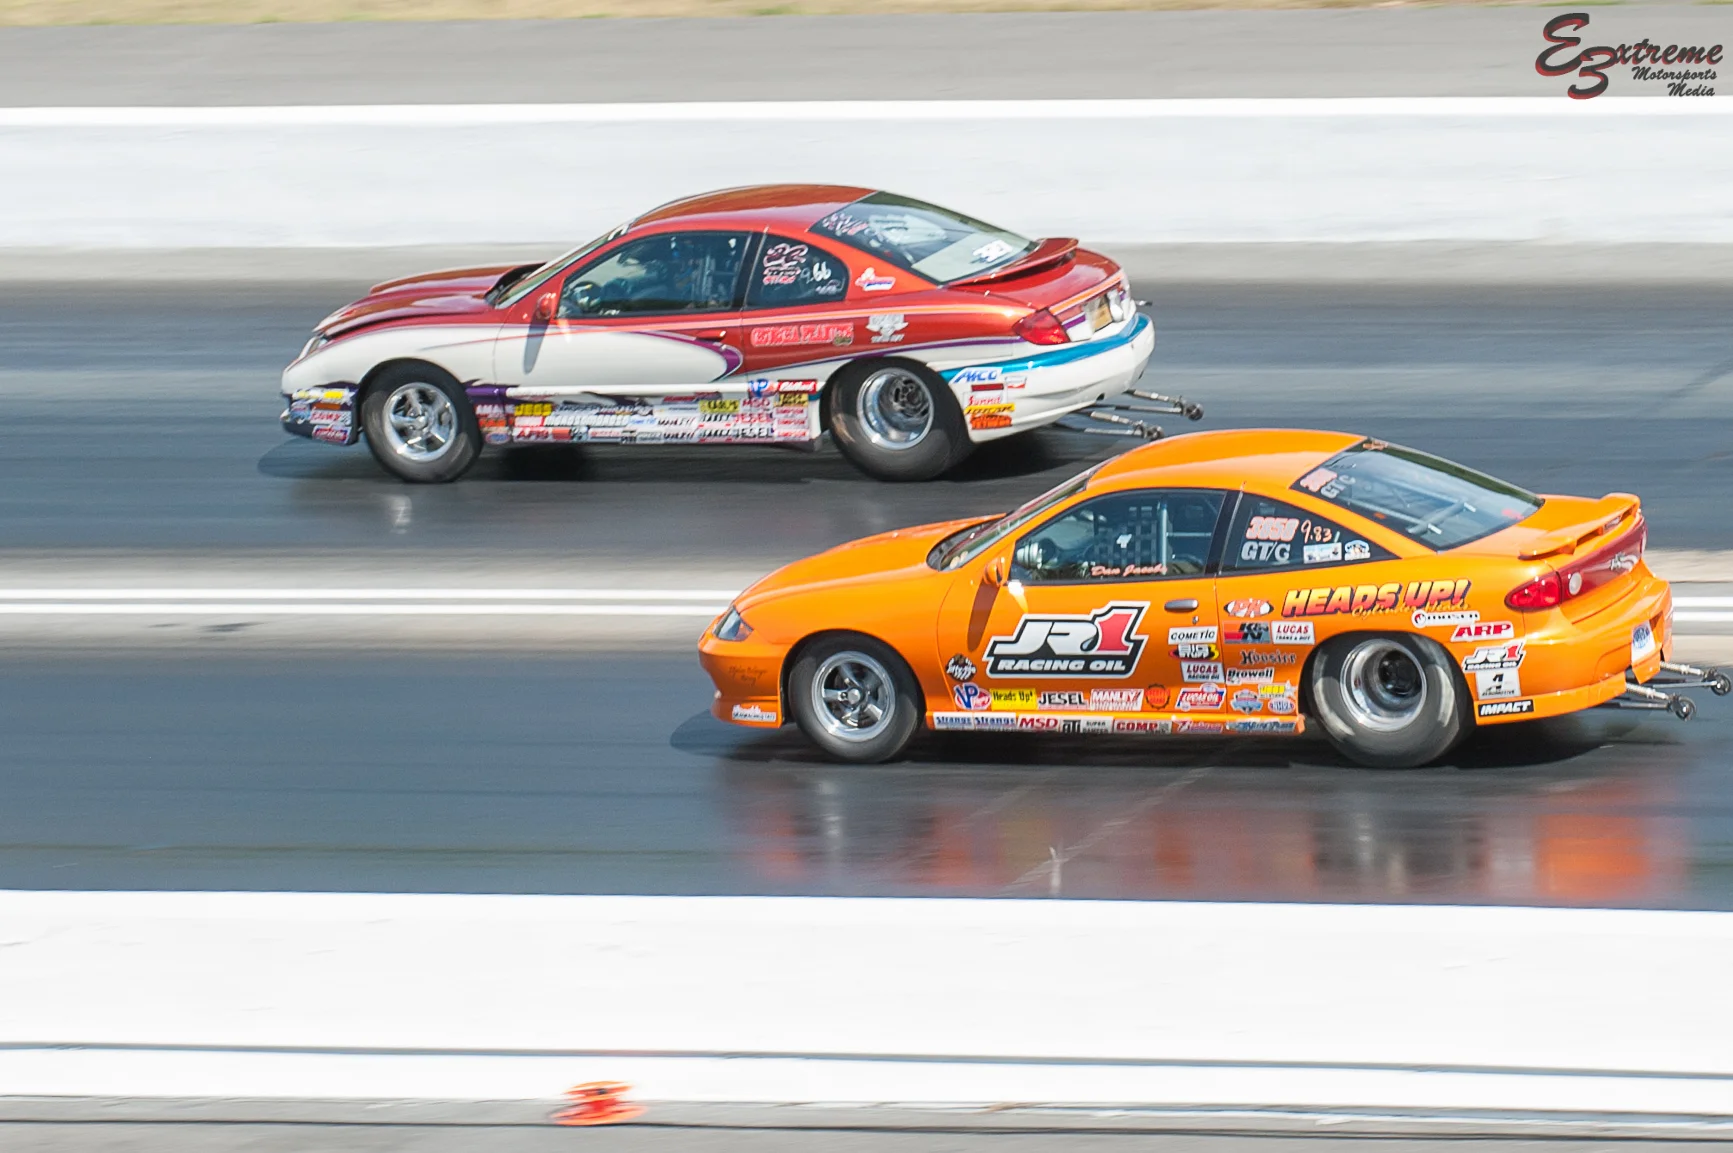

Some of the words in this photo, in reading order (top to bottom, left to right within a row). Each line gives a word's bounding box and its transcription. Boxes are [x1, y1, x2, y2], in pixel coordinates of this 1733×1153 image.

[1282, 583, 1403, 617] HEADS
[1403, 578, 1472, 609] UP!
[993, 608, 1140, 655] JR1
[1170, 630, 1216, 641] COMETIC
[1277, 625, 1309, 634] LUCAS
[1455, 624, 1512, 638] ARP
[1239, 649, 1297, 666] Hoosier
[997, 659, 1085, 671] RACING
[1089, 660, 1126, 671] OIL
[1186, 664, 1219, 674] LUCAS
[954, 684, 980, 709] VP
[1038, 693, 1086, 705] JESEL
[1480, 701, 1532, 716] IMPACT
[1020, 717, 1058, 728] MSD
[1116, 721, 1158, 731] COMP
